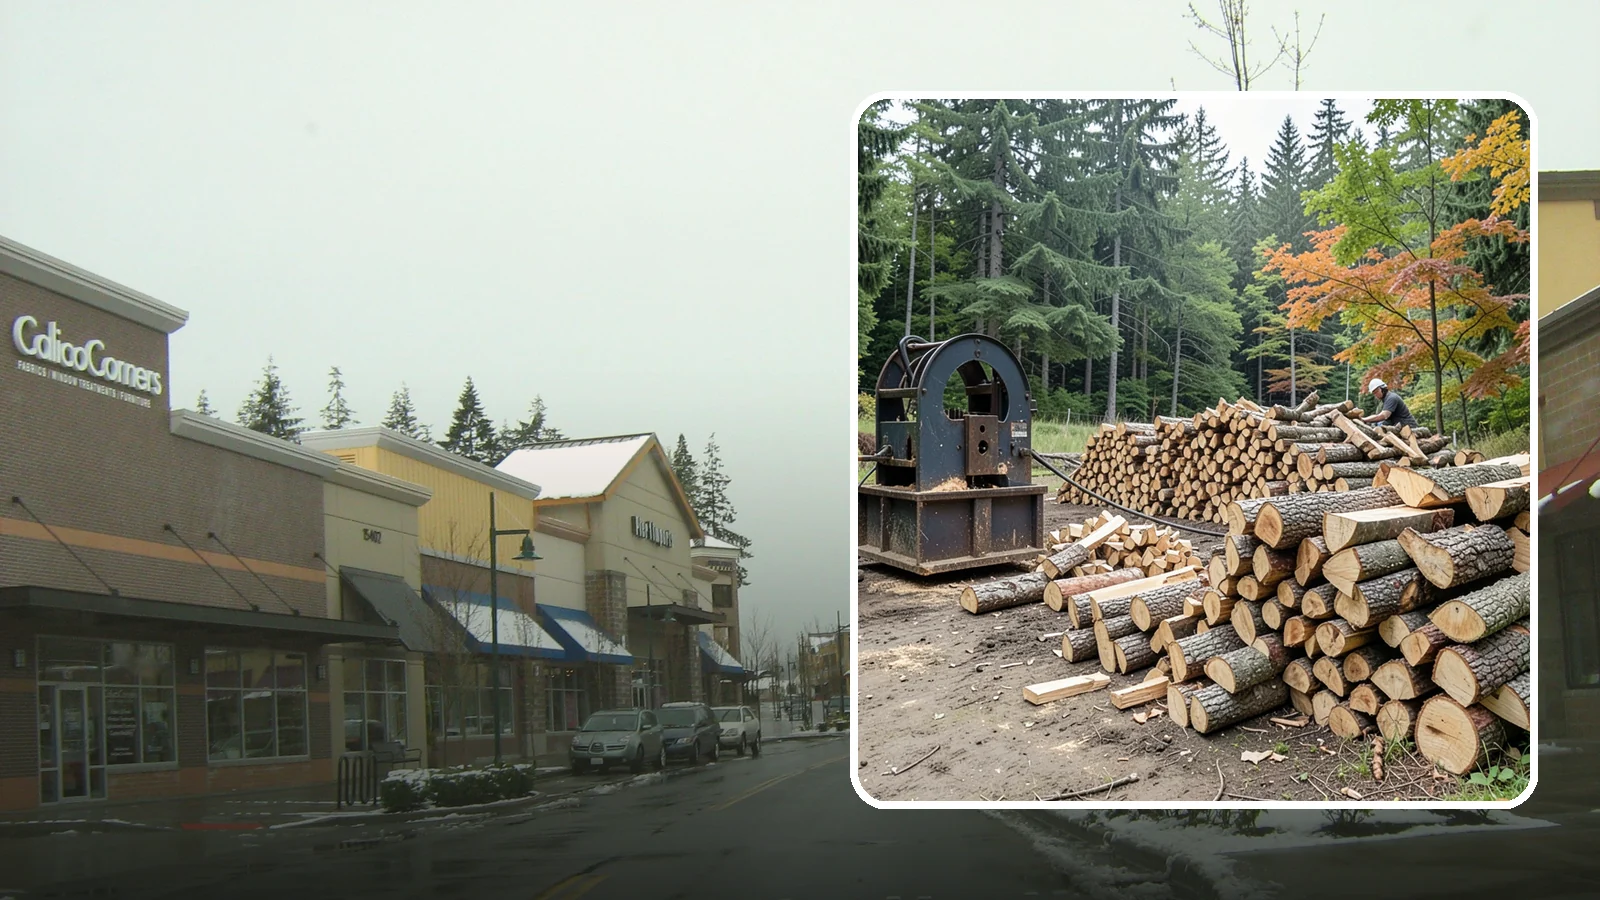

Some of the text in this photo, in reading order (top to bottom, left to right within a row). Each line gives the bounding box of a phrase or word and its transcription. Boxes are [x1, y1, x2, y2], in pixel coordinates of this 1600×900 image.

[17, 359, 151, 409] FABRICS WINDOW TREATMENTS FURNITURE
